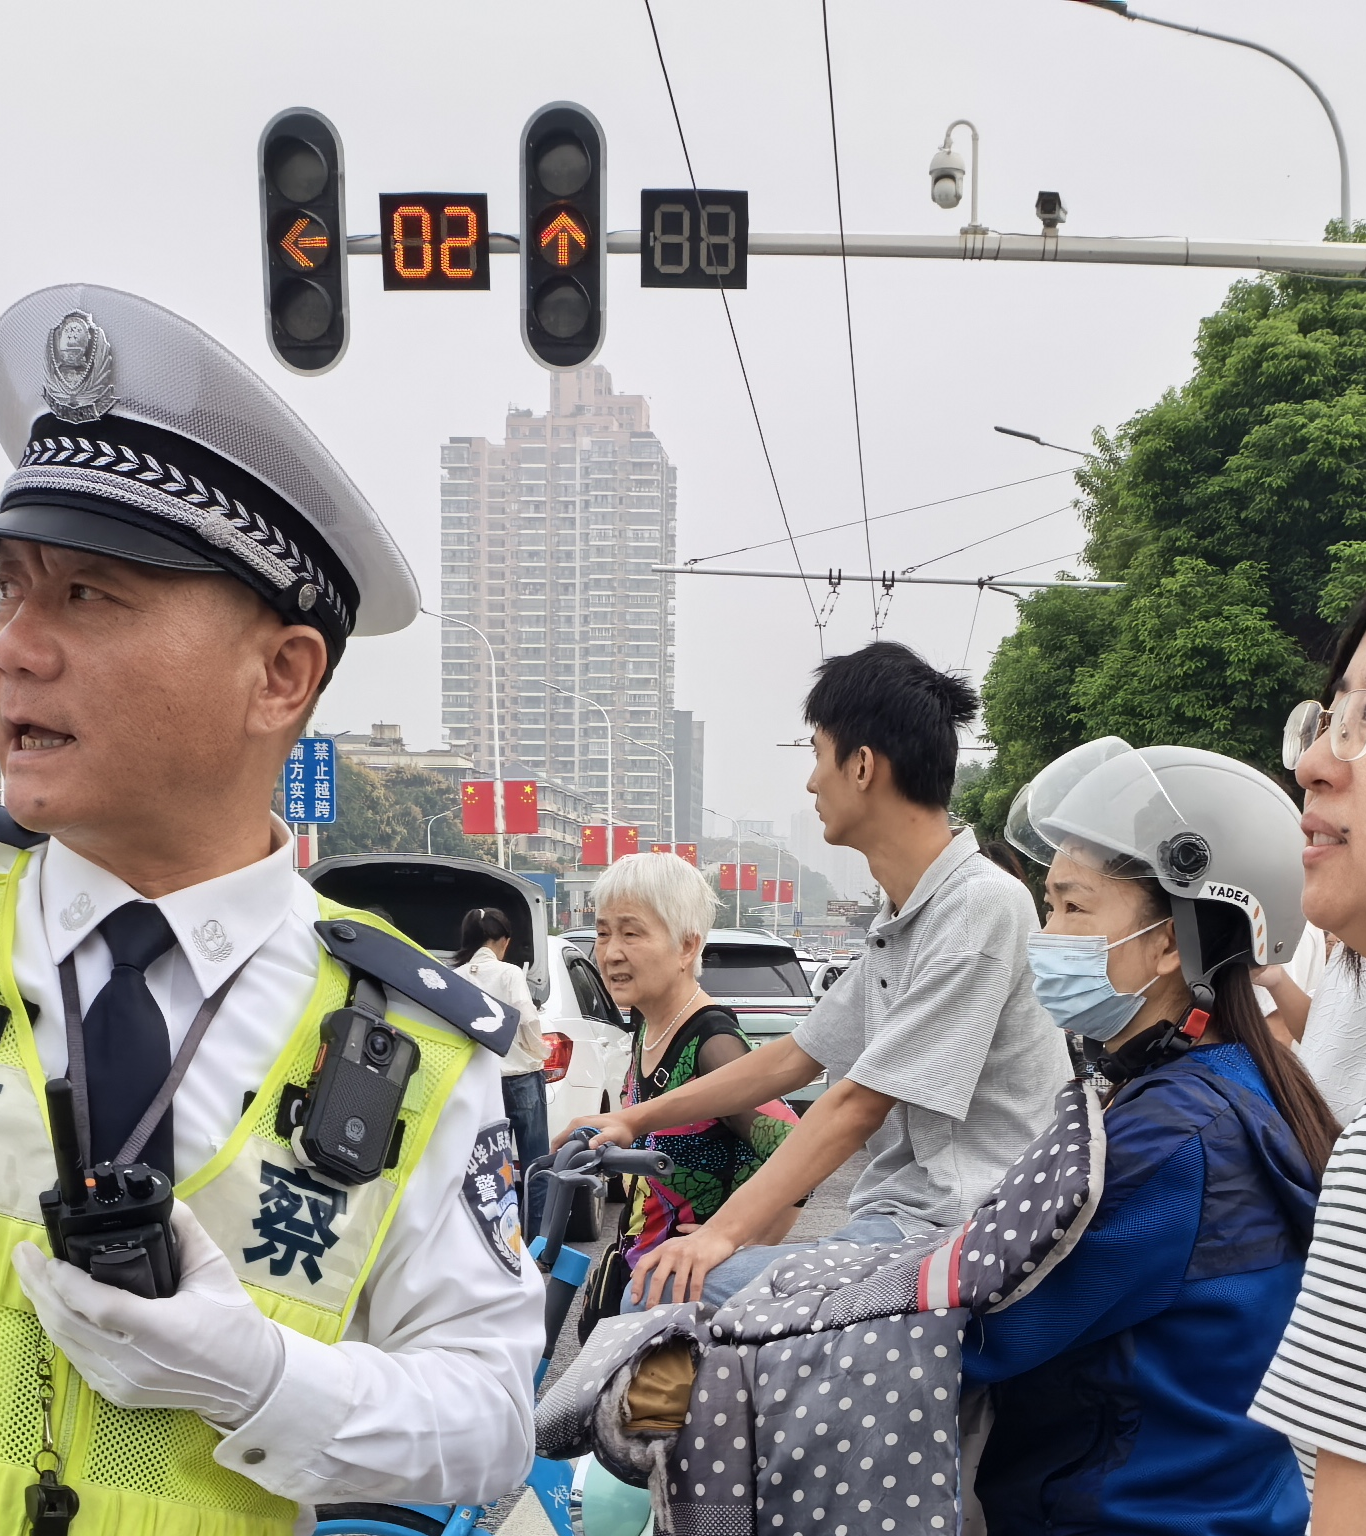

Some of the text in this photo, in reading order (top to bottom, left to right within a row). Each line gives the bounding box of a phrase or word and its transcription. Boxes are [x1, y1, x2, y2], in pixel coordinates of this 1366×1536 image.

[392, 205, 477, 279] 02
[289, 742, 305, 819] 前方实线
[313, 741, 331, 818] 禁止越跨
[1208, 885, 1250, 906] YADEA
[242, 1159, 348, 1286] 察
[474, 1173, 498, 1202] 警
